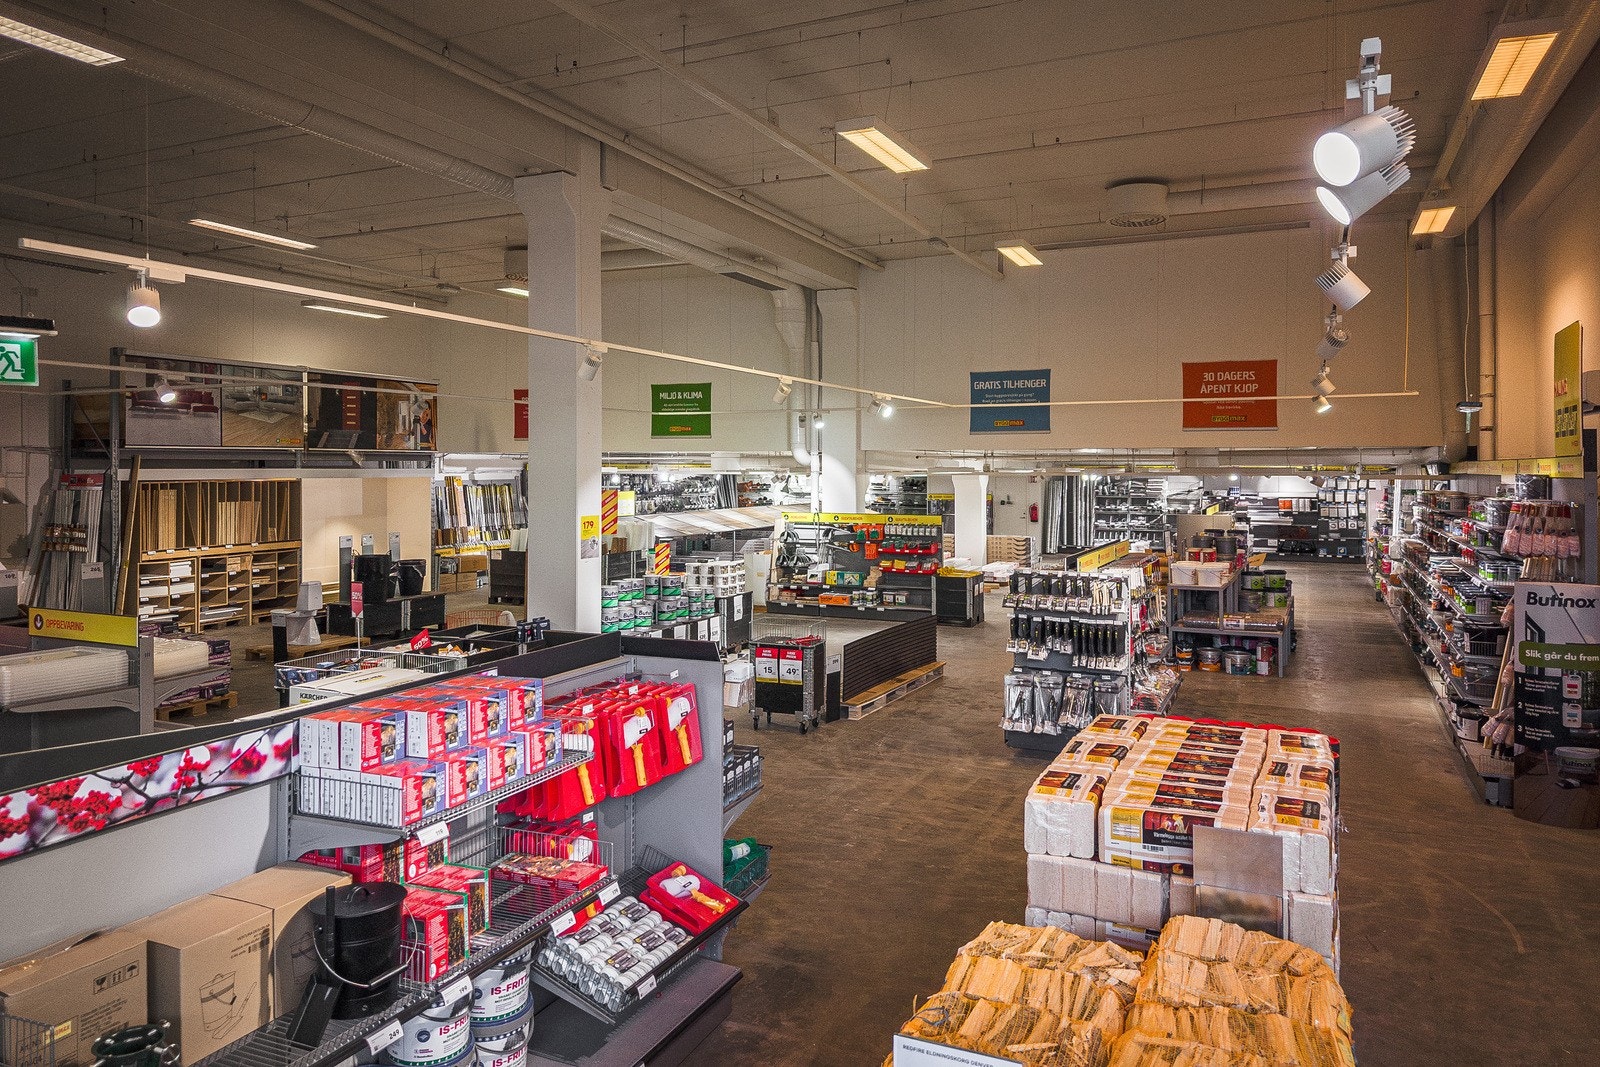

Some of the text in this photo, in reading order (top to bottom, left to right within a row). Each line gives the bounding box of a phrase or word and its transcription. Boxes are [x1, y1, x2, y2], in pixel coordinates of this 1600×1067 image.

[1203, 371, 1256, 382] 30 DAGERS
[974, 379, 1047, 390] GRATIS TILHENGER
[1200, 383, 1231, 394] ÅPENT
[683, 391, 703, 399] KLIMA
[583, 521, 594, 529] 179
[1526, 591, 1596, 608] Butinox
[46, 618, 84, 631] OPPBEVARING
[413, 636, 429, 650] 50%
[1525, 649, 1541, 658] Slik
[1544, 652, 1562, 660] går
[1579, 653, 1600, 662] frem
[763, 666, 773, 674] 15
[389, 1029, 400, 1040] 249
[903, 1044, 925, 1054] REDFIRE
